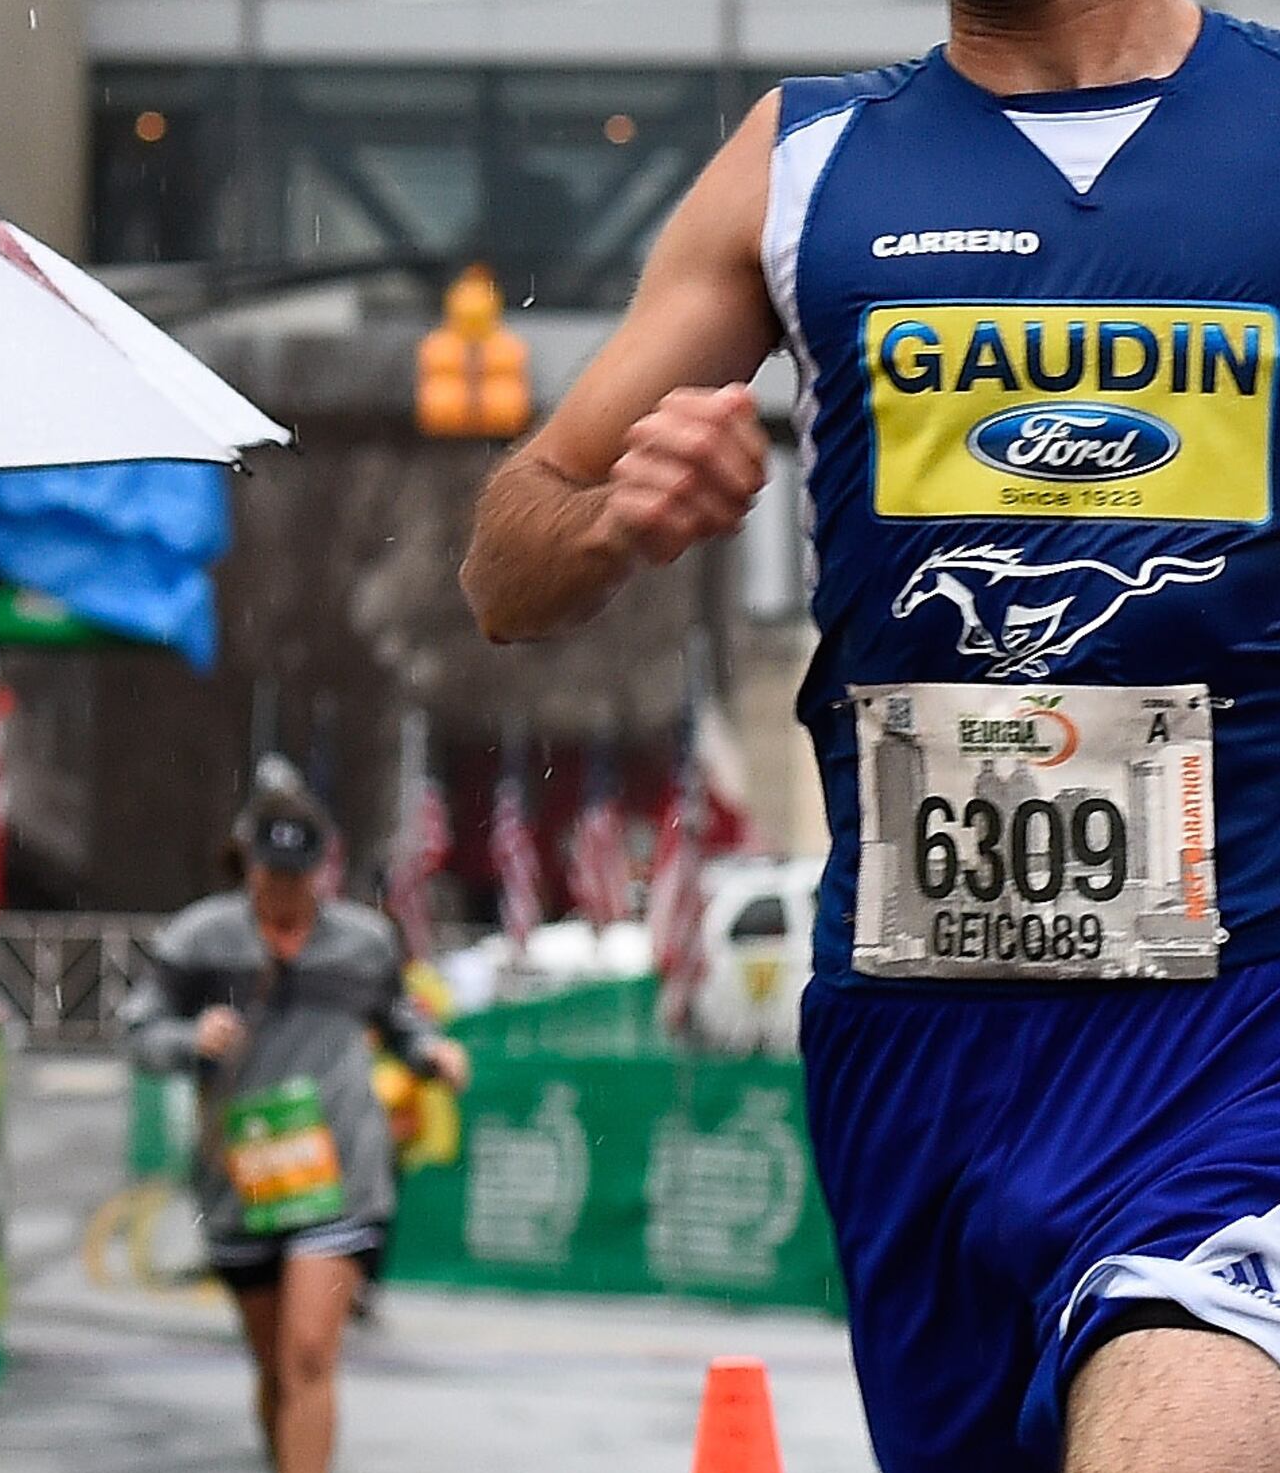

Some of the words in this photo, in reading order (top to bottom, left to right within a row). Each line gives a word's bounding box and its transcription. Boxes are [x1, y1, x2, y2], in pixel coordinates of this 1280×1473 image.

[872, 230, 1039, 258] CARRENO
[879, 319, 1261, 396] GAUDIN
[1006, 412, 1140, 468] Ford
[1000, 487, 1070, 507] Since
[1080, 489, 1142, 507] 1923
[1148, 712, 1169, 744] A
[916, 795, 1127, 903] 6309
